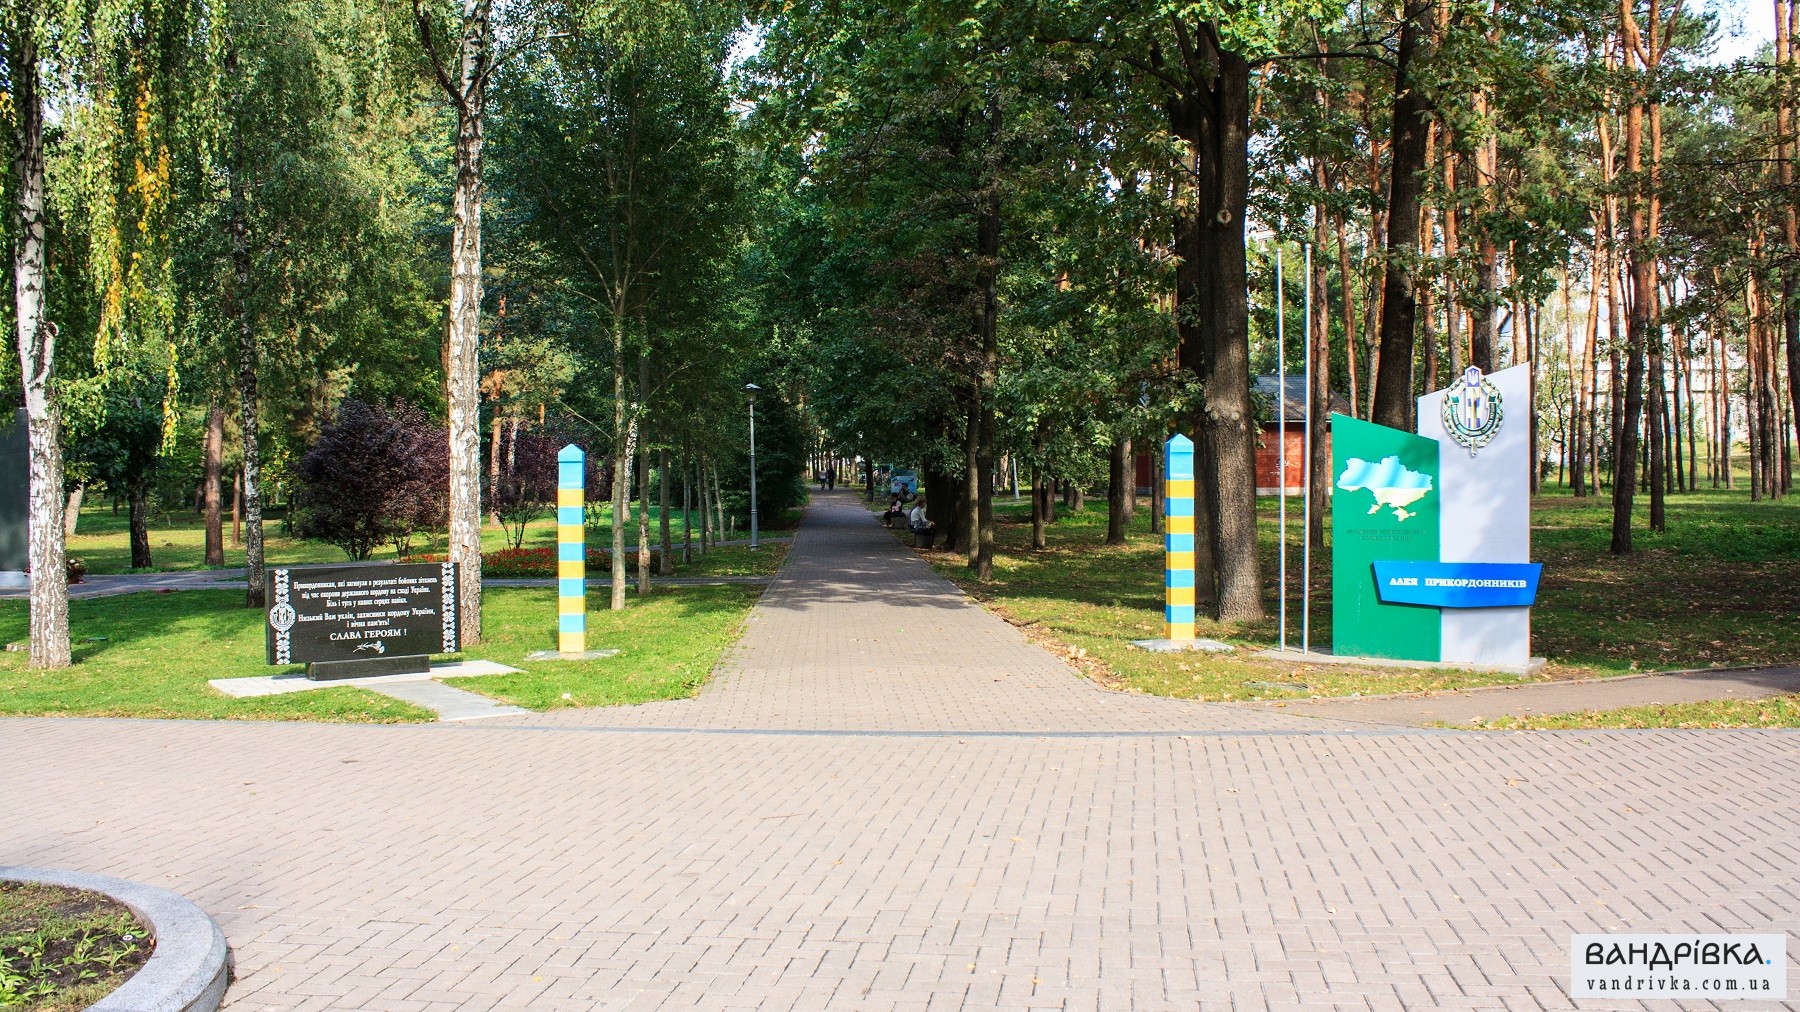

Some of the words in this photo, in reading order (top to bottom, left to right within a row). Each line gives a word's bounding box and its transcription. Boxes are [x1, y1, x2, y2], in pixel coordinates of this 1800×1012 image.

[1389, 577, 1419, 586] АЛЕЯ
[1424, 578, 1527, 588] ПРИКОРДОННИКІВ
[298, 614, 323, 622] Низький
[324, 612, 336, 620] Вам
[338, 612, 355, 621] уклін,
[387, 610, 410, 618] кордону
[330, 630, 362, 640] СЛАВА
[364, 628, 402, 638] ГЕРОЯМ
